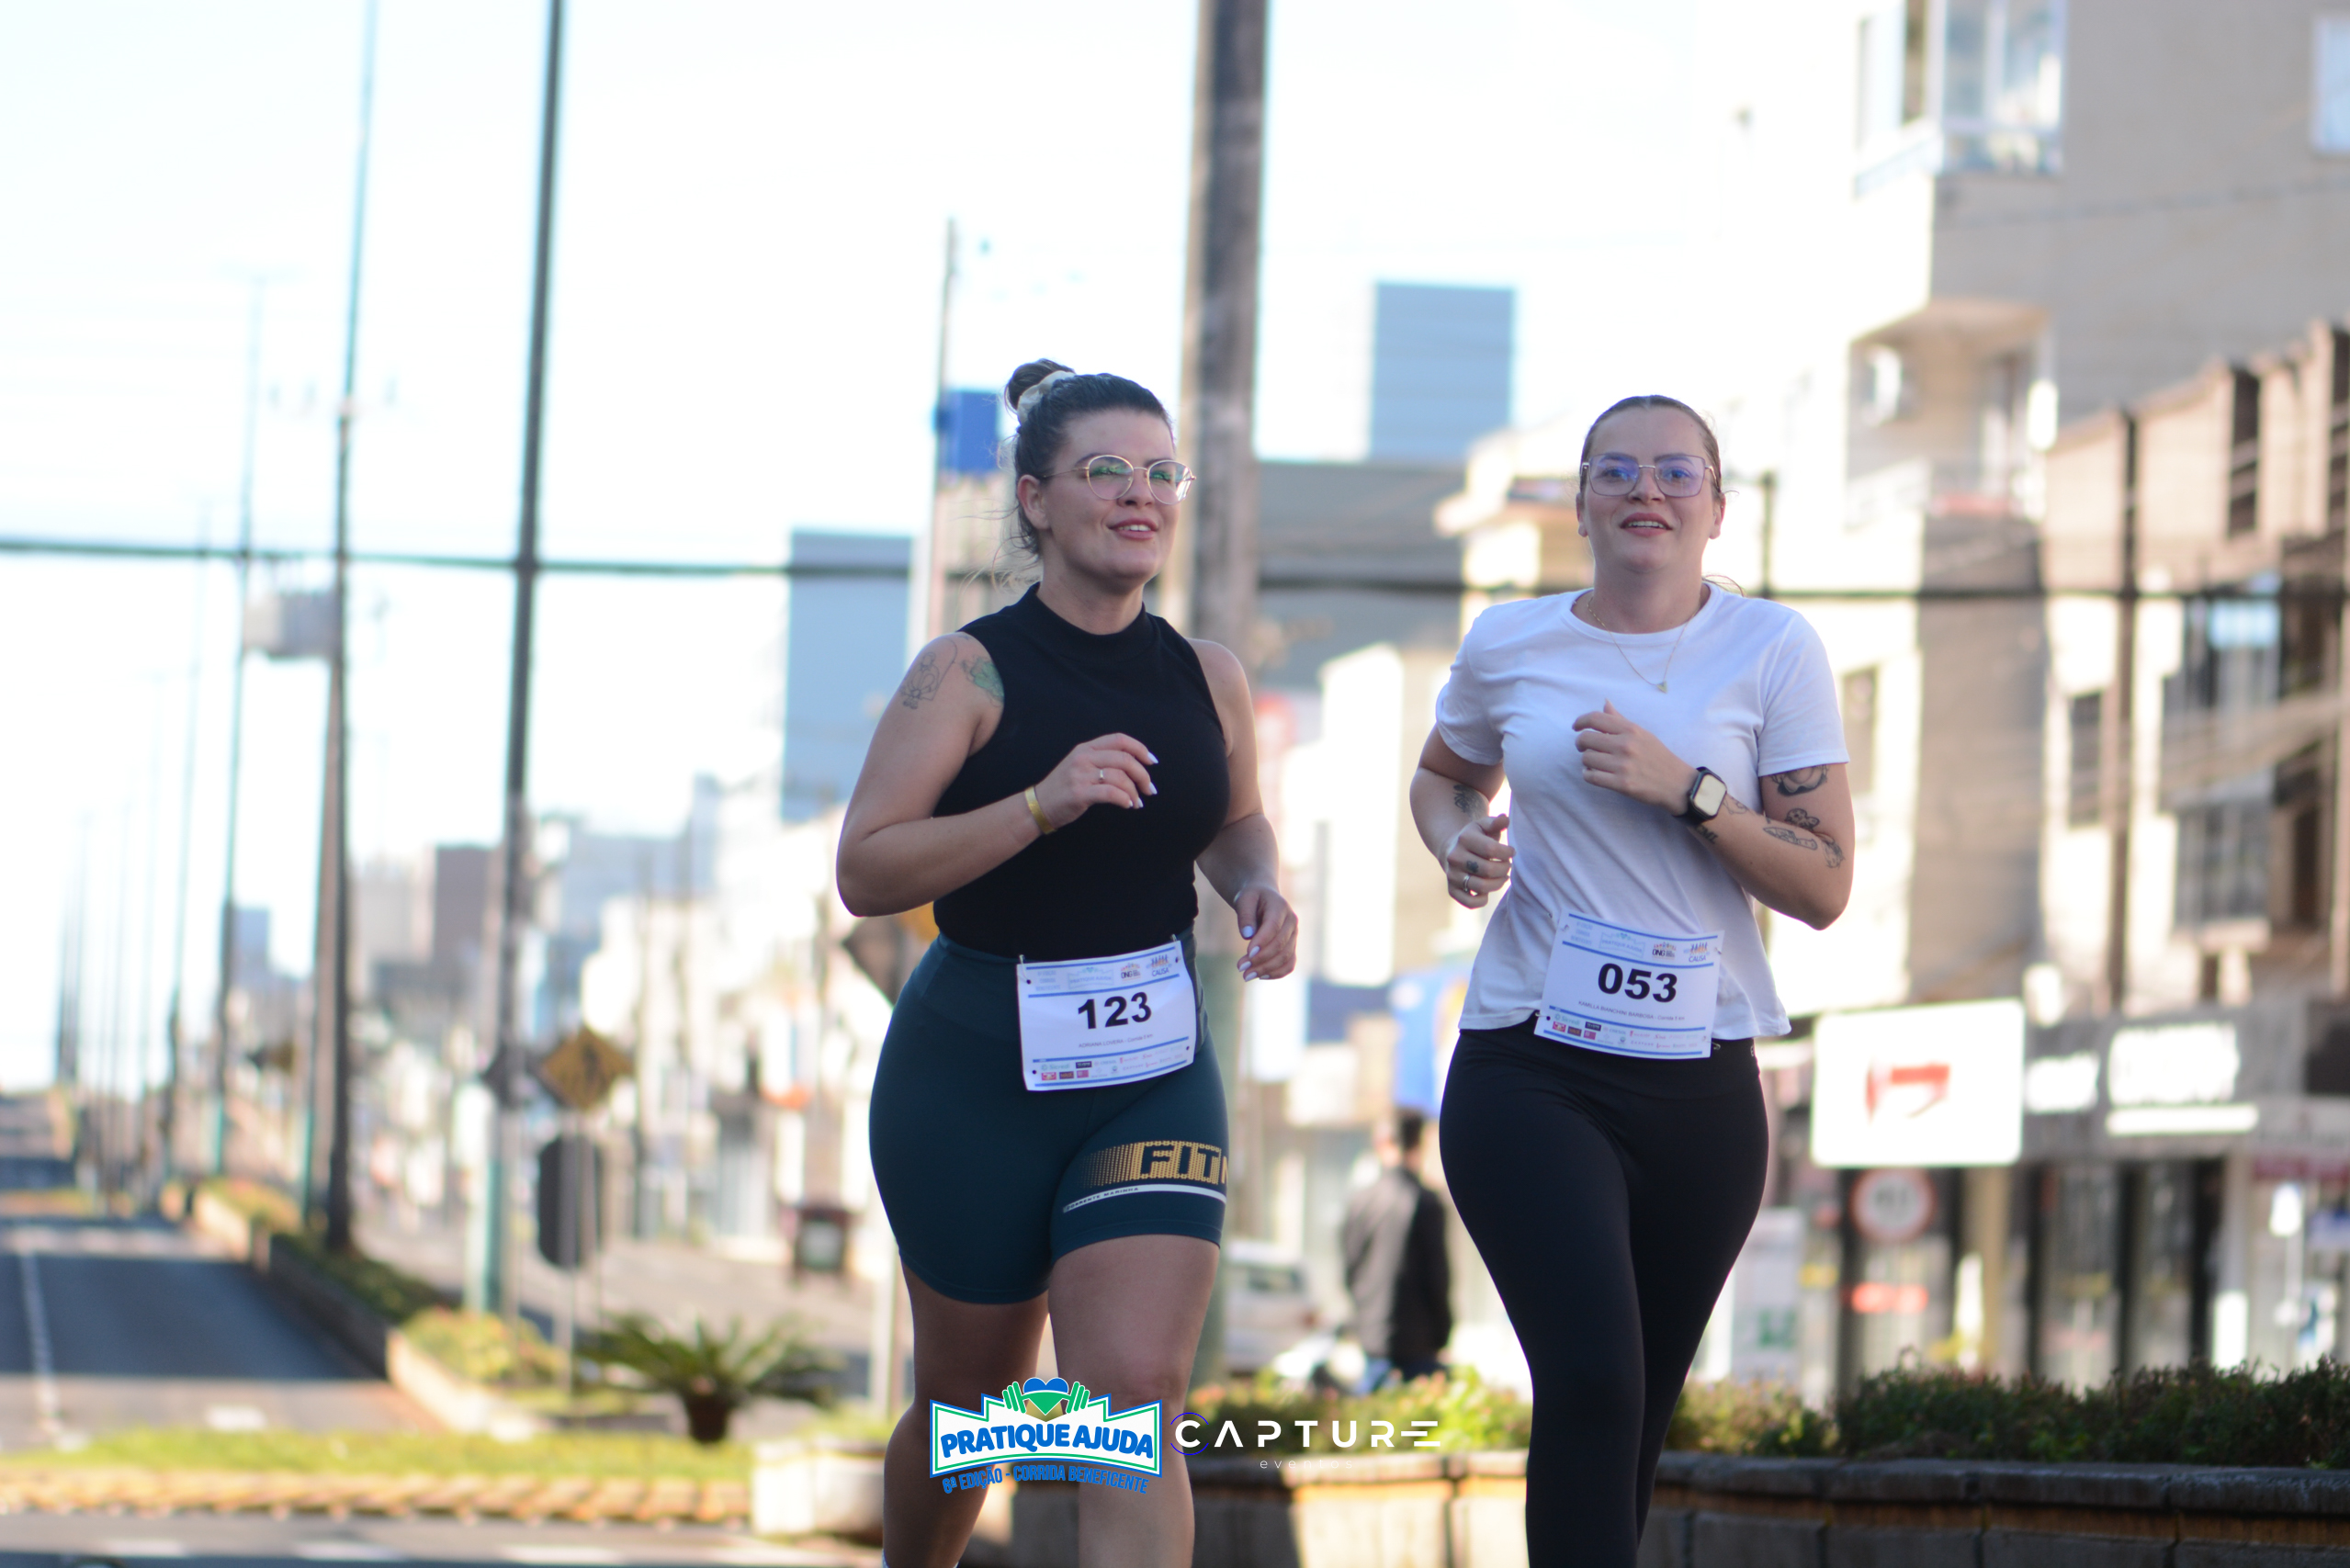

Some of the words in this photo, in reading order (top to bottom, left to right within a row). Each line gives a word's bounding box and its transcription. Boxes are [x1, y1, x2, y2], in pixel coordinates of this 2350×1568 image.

[1689, 954, 1706, 963] CAUSA
[1151, 967, 1169, 976] CAUSA
[1598, 963, 1678, 1003] 053
[1078, 991, 1152, 1030] 123
[1578, 1000, 1599, 1010] KAMILLA
[1628, 1011, 1654, 1020] BARBOSA
[1079, 1041, 1102, 1049] ADRIANA
[1103, 1187, 1139, 1197] MARINHA
